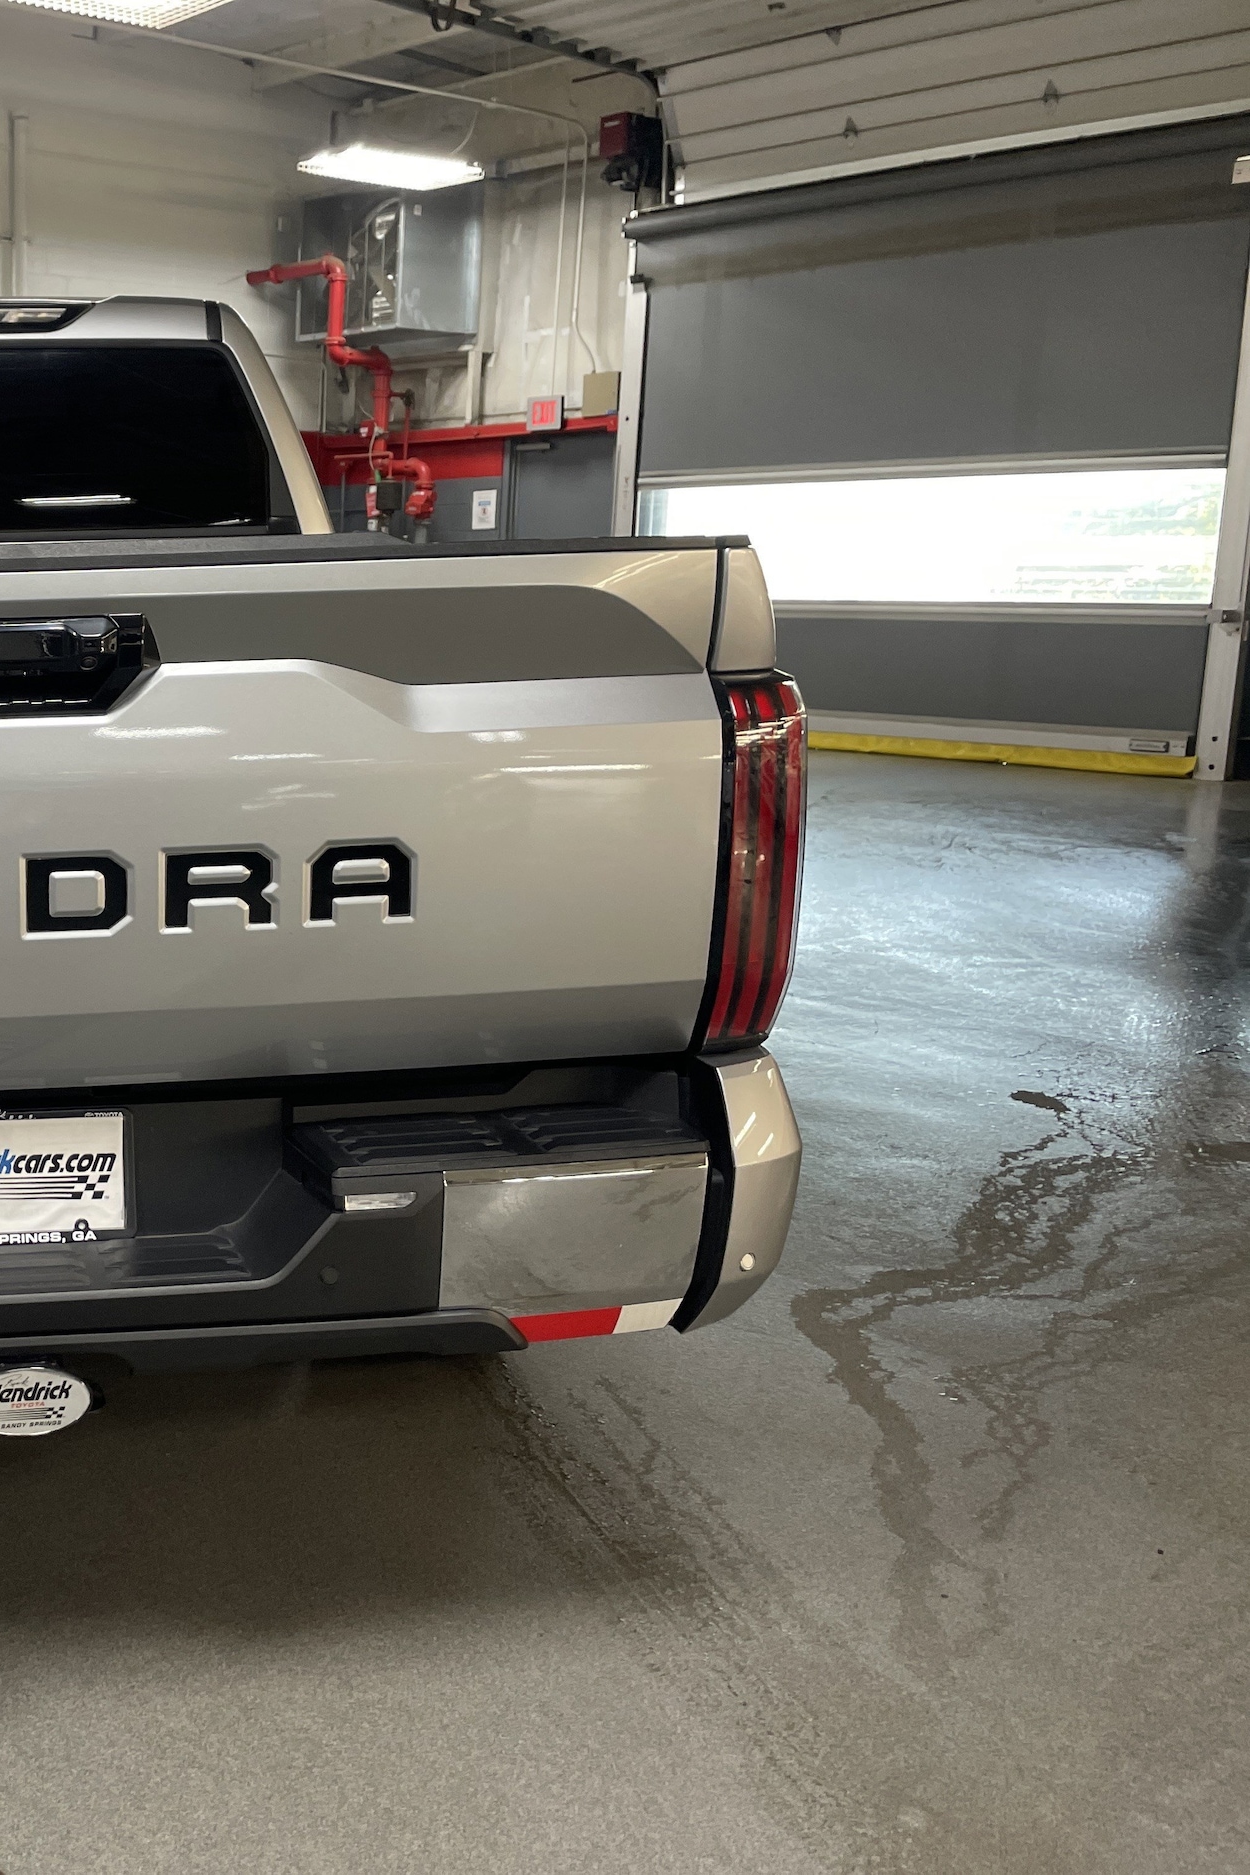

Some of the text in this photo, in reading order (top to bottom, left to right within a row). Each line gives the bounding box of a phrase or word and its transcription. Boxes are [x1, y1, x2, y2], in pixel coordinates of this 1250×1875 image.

[532, 400, 556, 425] EXIT
[71, 1231, 97, 1242] GA
[10, 1401, 45, 1409] TOYOTA
[29, 1420, 62, 1428] SPRINGS
